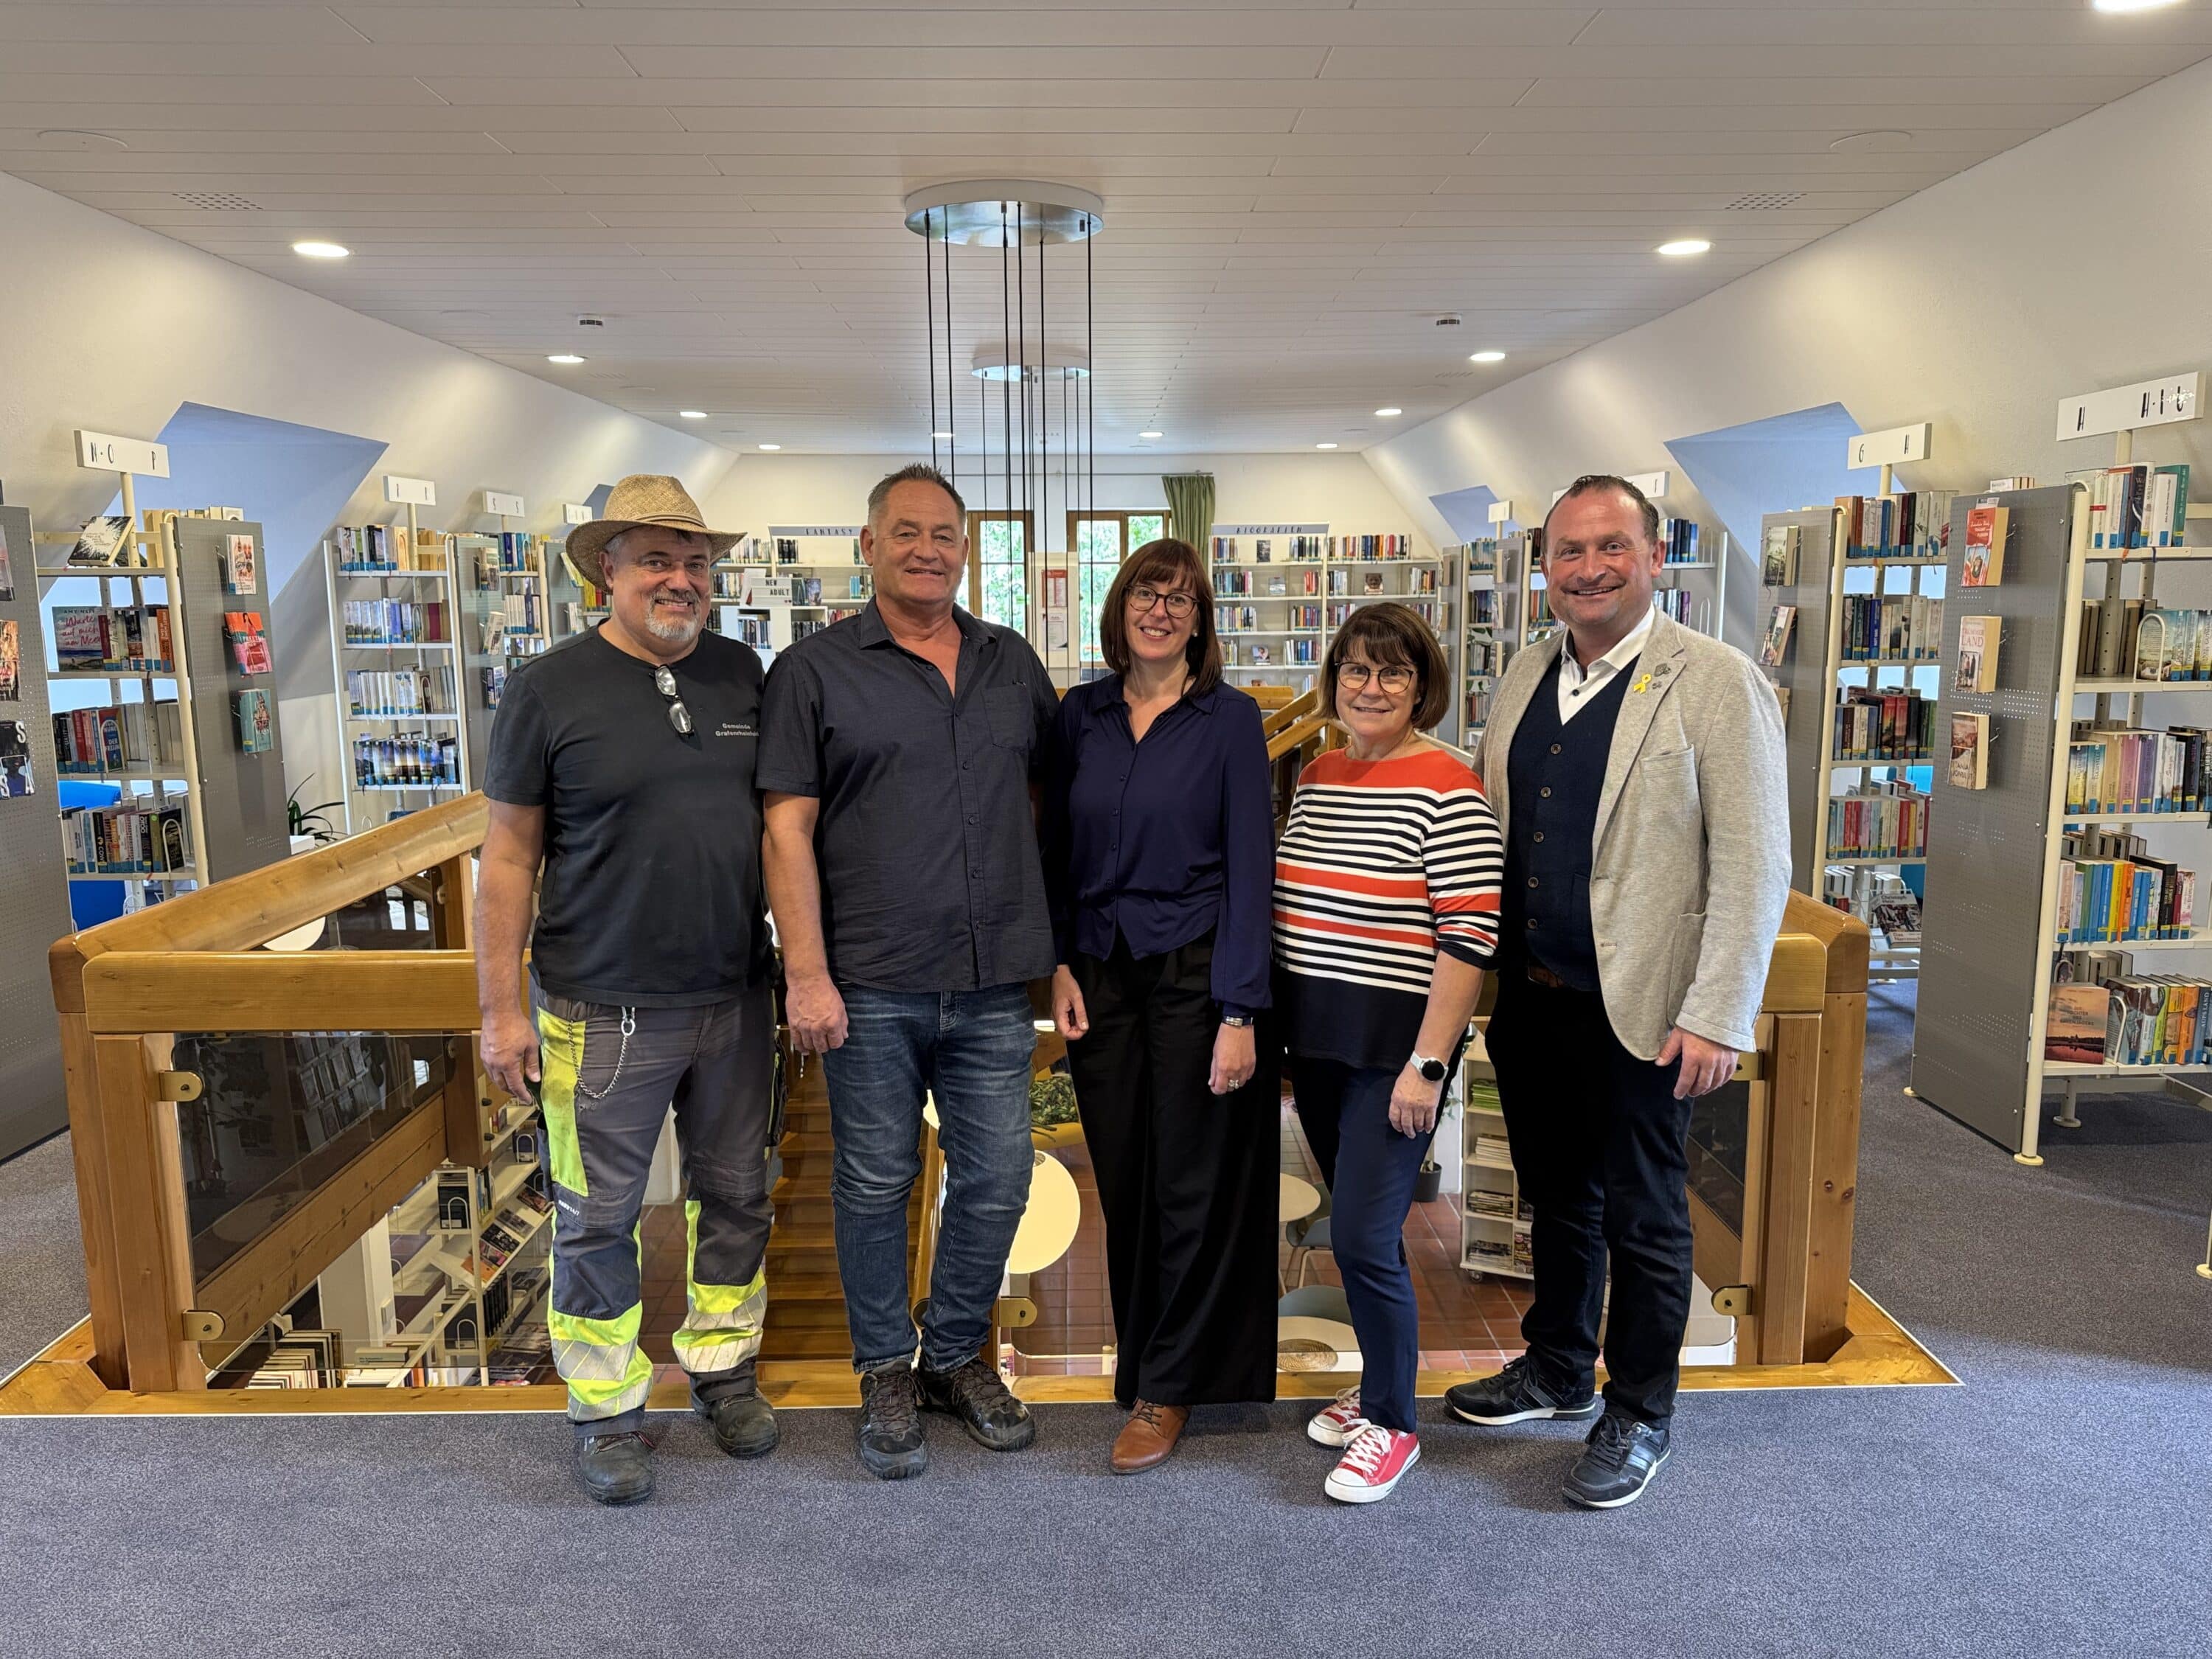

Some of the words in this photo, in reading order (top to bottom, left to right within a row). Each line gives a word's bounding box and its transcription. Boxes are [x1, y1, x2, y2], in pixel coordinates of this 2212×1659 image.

[805, 527, 852, 536] FANTASY
[1236, 526, 1303, 535] BIOGRAFIEN
[66, 615, 95, 627] Warte
[1961, 636, 1983, 647] LAND
